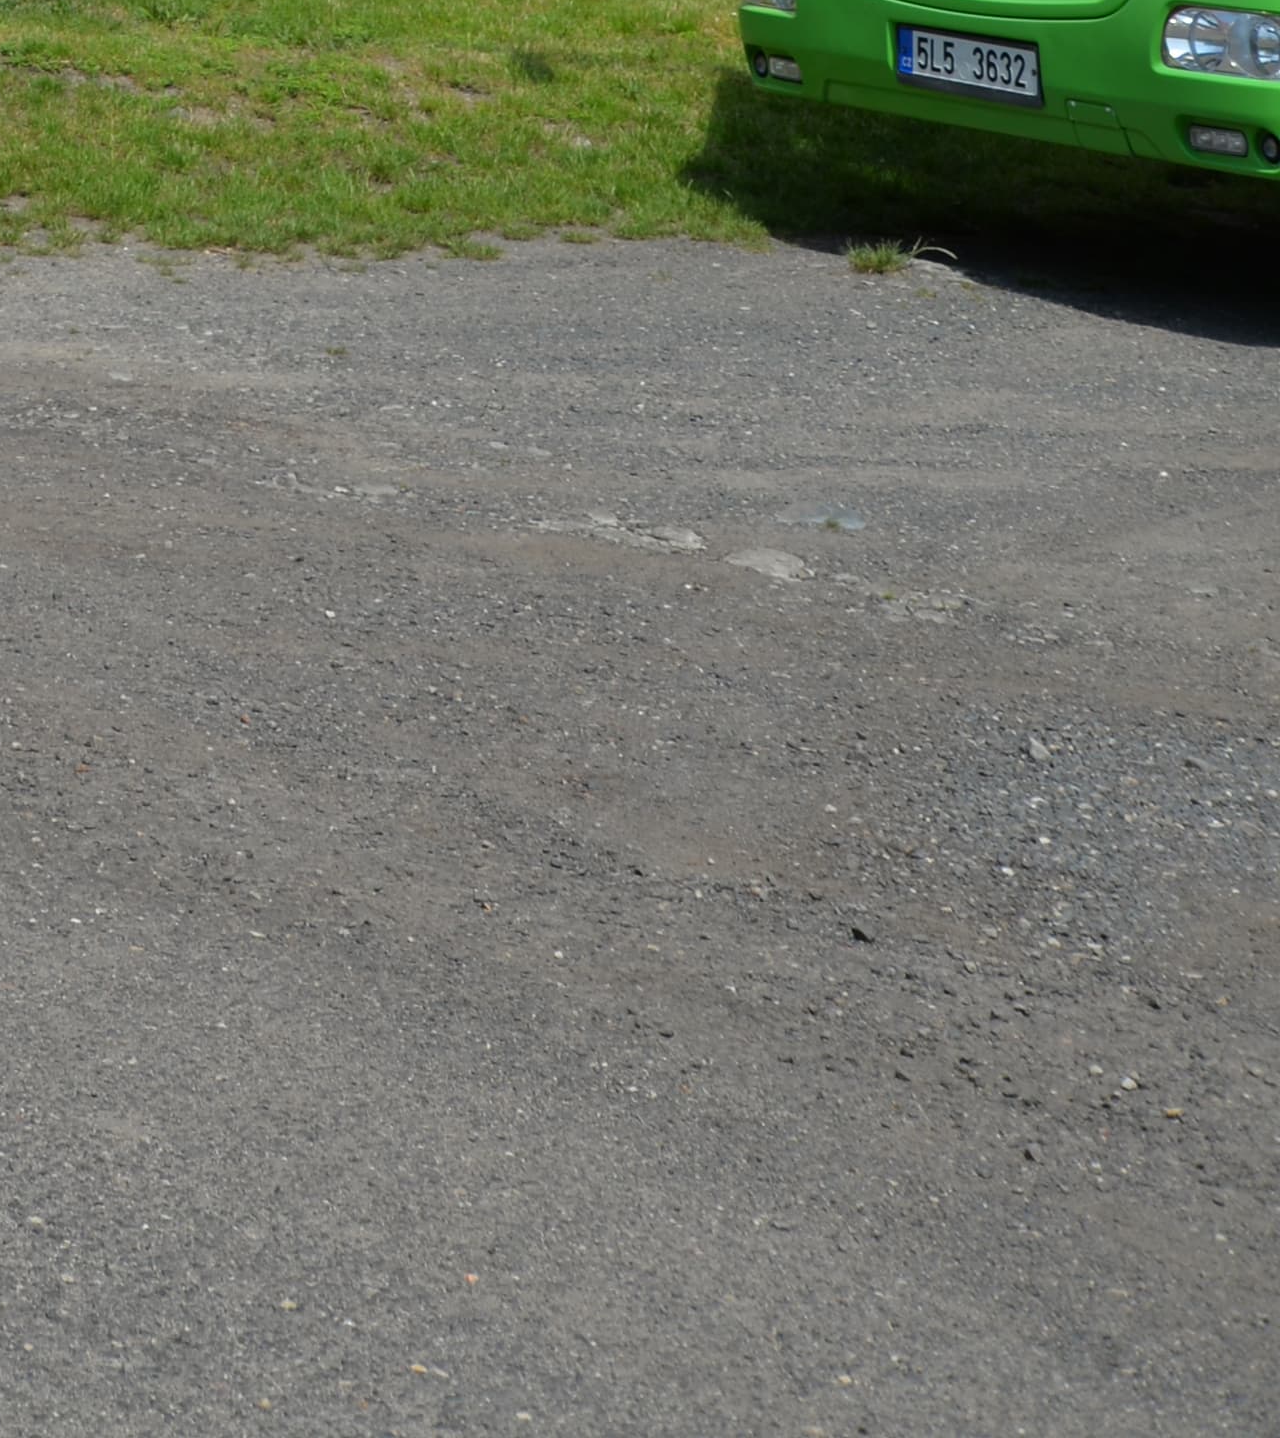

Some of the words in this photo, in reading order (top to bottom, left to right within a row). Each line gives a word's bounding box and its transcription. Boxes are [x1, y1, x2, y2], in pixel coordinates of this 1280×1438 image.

[901, 55, 913, 68] CZ
[917, 37, 955, 74] 5L5
[972, 47, 1027, 88] 3632
